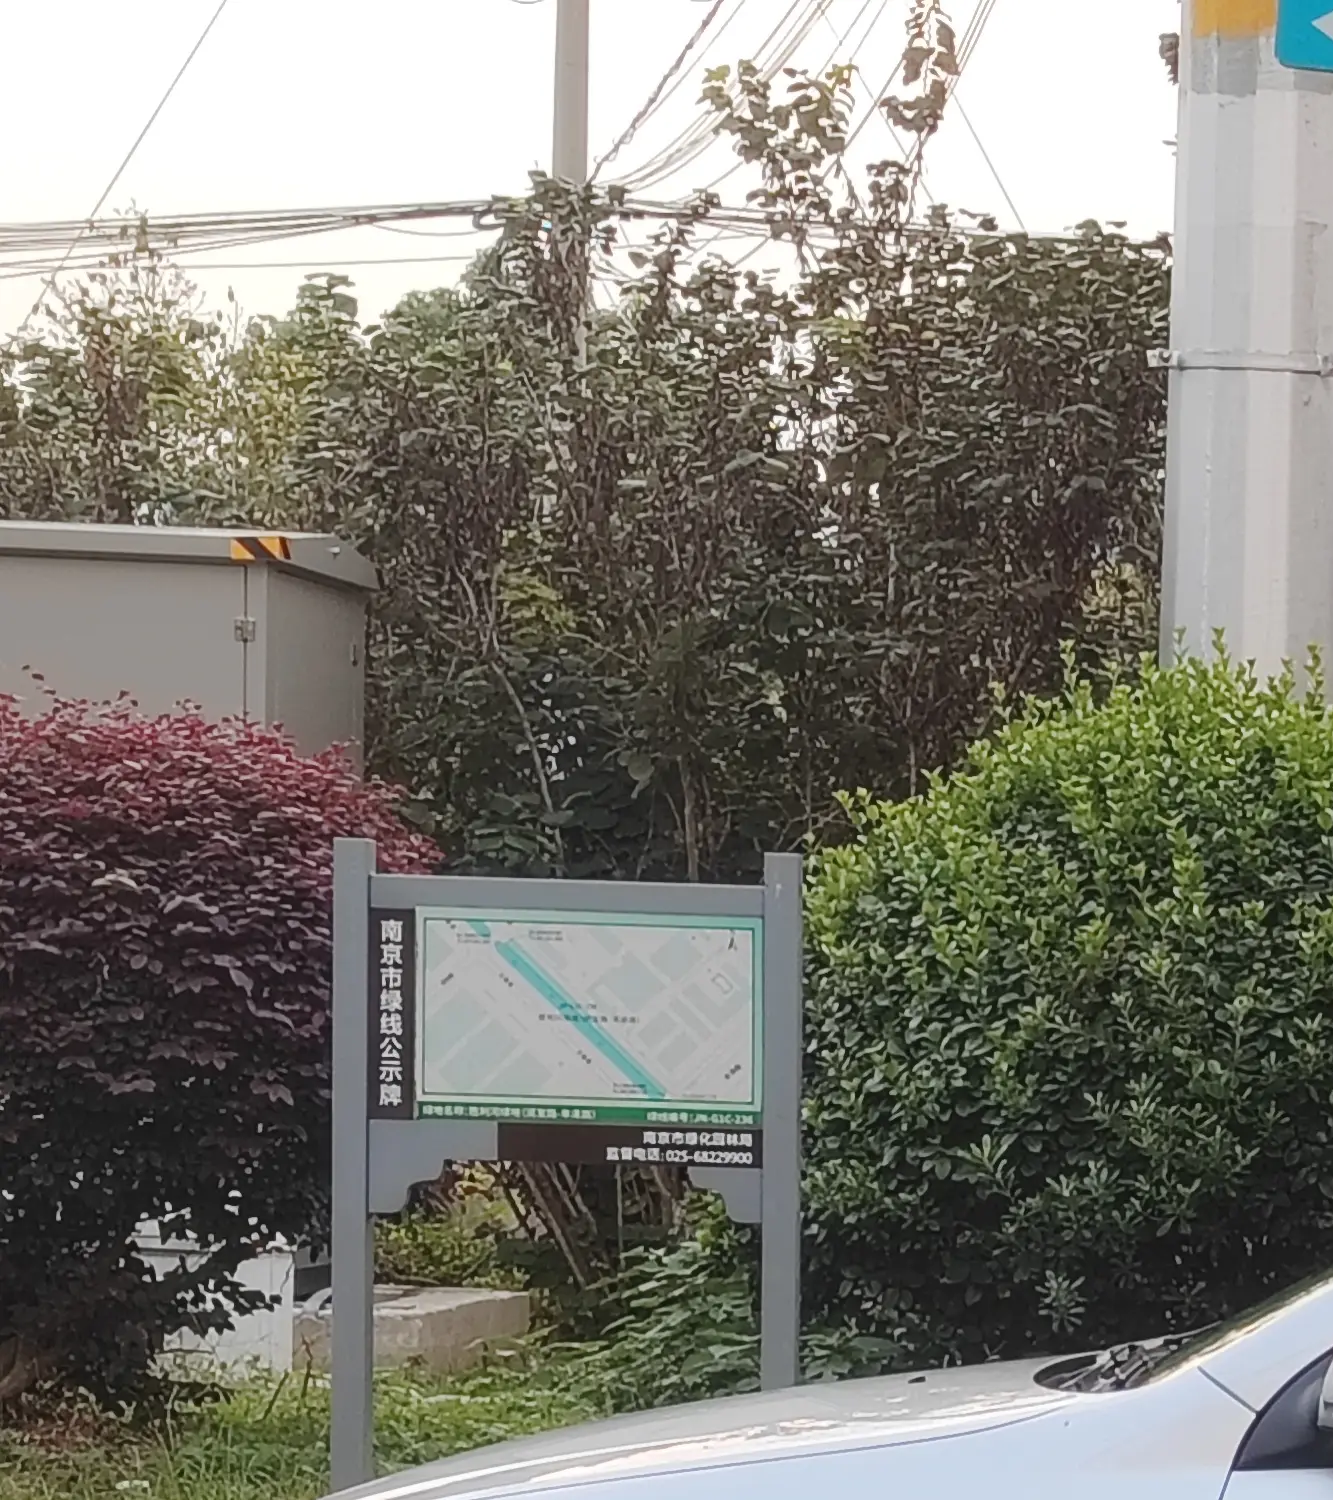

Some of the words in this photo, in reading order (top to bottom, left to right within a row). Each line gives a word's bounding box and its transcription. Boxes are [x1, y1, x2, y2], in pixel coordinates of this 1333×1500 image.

[379, 918, 404, 1107] 南京市绿线公示牌
